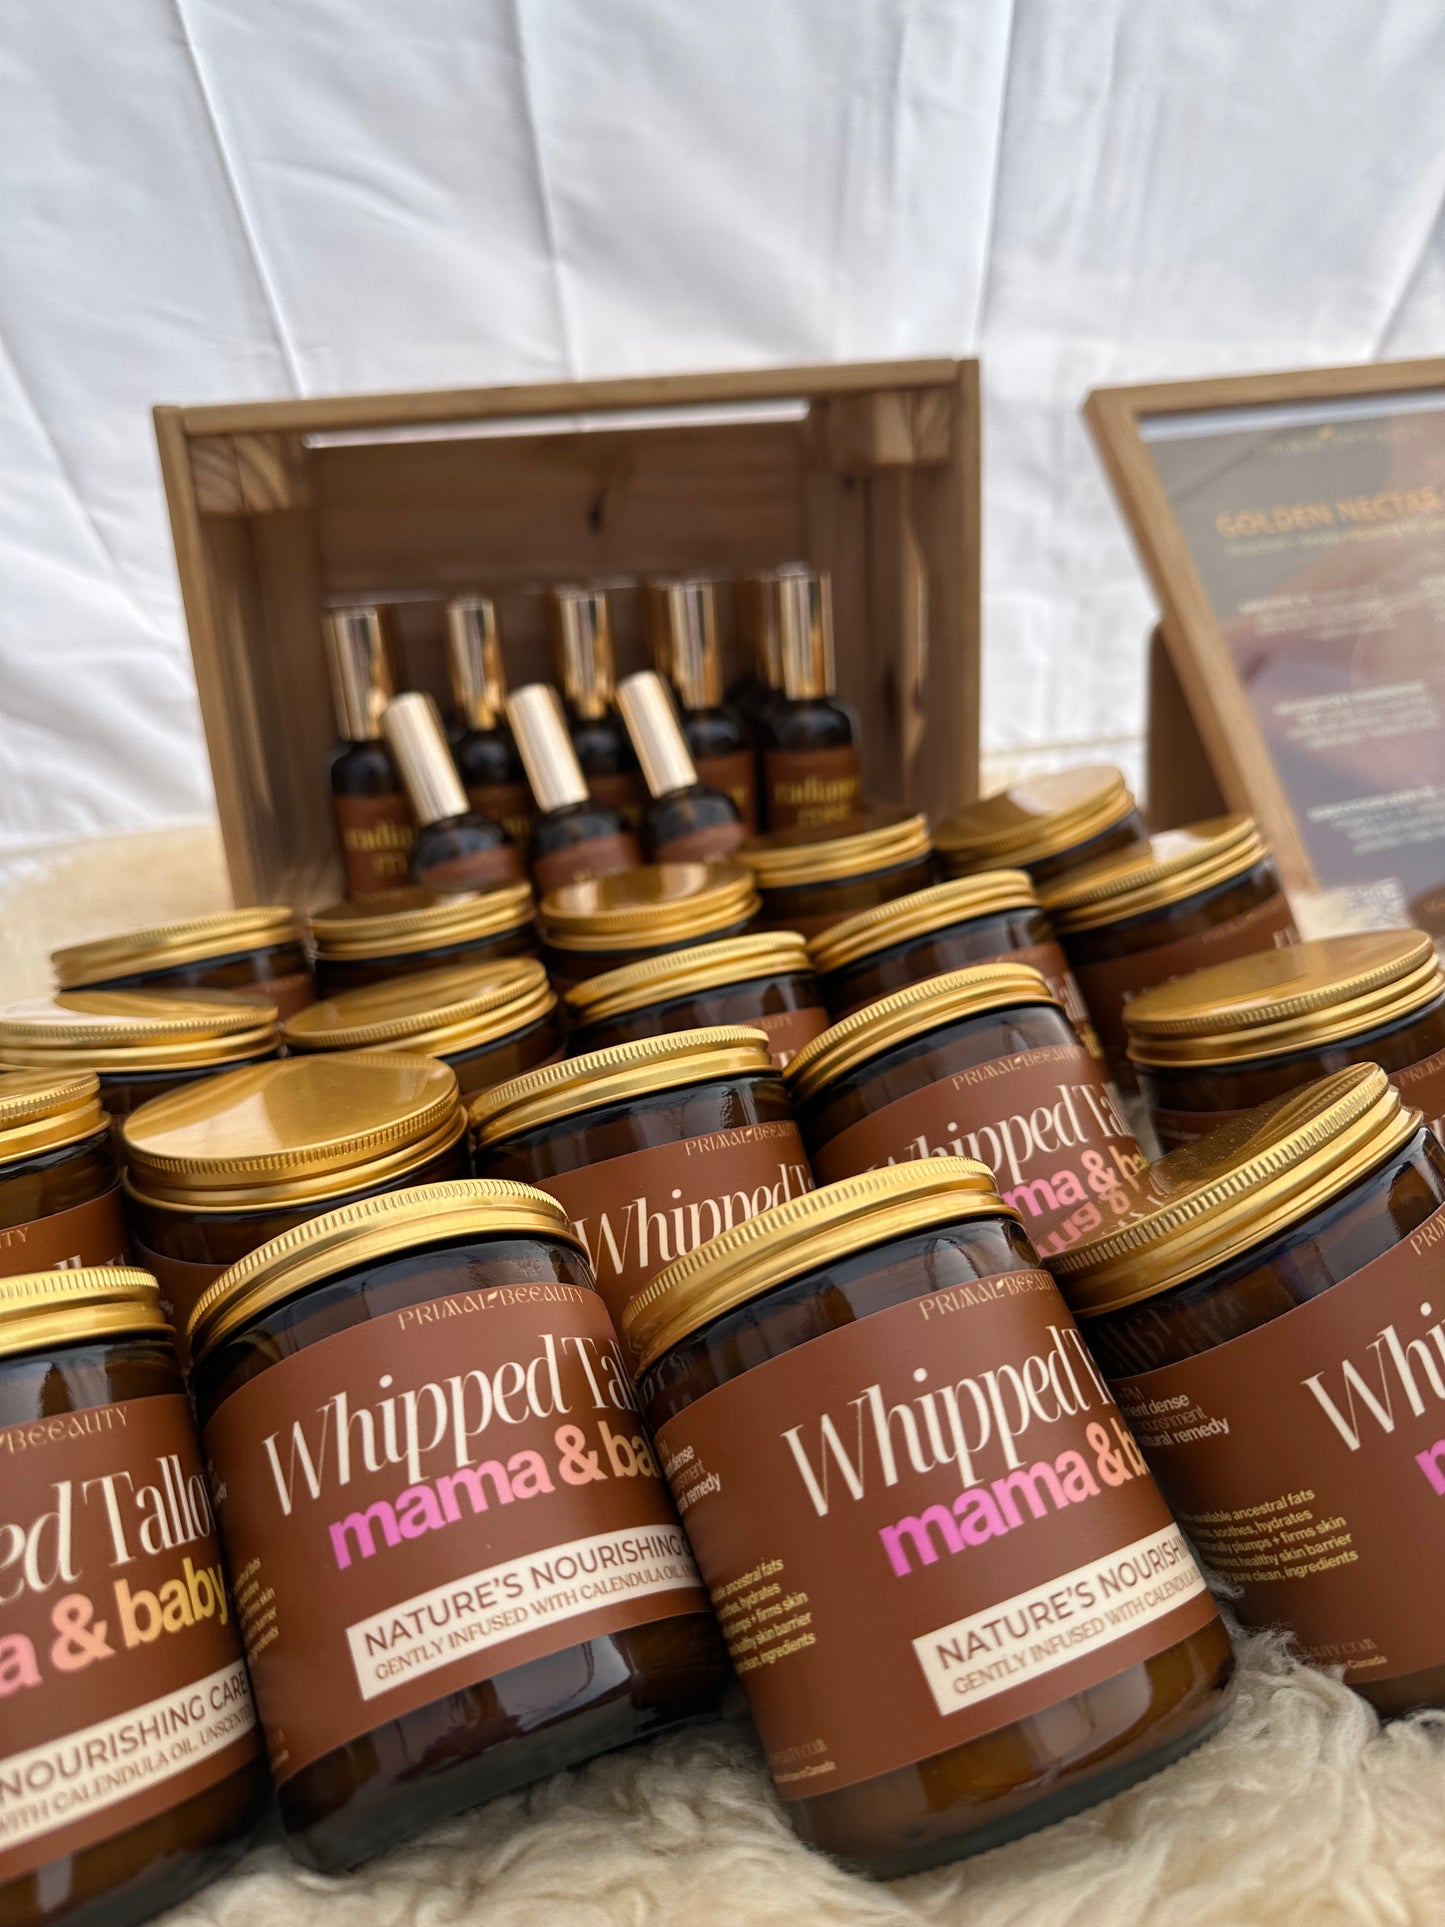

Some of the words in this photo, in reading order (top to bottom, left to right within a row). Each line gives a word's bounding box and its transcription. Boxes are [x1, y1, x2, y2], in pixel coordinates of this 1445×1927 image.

[952, 1059, 1022, 1091] PRIMAL
[685, 1132, 752, 1156] PRIMAL
[1002, 1169, 1088, 1217] ma
[1080, 1149, 1122, 1193] &
[1410, 1213, 1445, 1256] PRIM
[398, 1293, 495, 1331] PRIMAL
[499, 1285, 585, 1307] BEEAUTY
[918, 1281, 1005, 1321] PRIMAL
[262, 1333, 573, 1516] Whipped
[780, 1325, 1090, 1517] Whipped
[1149, 1394, 1190, 1415] dense
[7, 1405, 128, 1453] BEEAUTY
[1173, 1416, 1231, 1445] remedy
[329, 1450, 557, 1571] mama
[554, 1424, 608, 1486] &
[686, 1472, 721, 1505] remedy
[878, 1450, 1101, 1578] mama
[1086, 1421, 1134, 1488] &
[1232, 1496, 1289, 1522] ancestral
[1287, 1487, 1316, 1508] fats
[81, 1454, 217, 1568] Tallo
[1256, 1508, 1314, 1534] hydrates
[1279, 1525, 1317, 1545] firms
[1314, 1514, 1348, 1535] skin
[1278, 1545, 1308, 1563] skin
[1306, 1532, 1352, 1558] barrier
[1284, 1548, 1360, 1579] ingredients
[51, 1593, 116, 1662] &
[113, 1556, 229, 1649] baby
[364, 1571, 524, 1657] NATURE'S
[530, 1534, 683, 1591] NOURISHING
[782, 1591, 809, 1612] skin
[375, 1637, 447, 1681] GENTLY
[450, 1605, 530, 1649] INFUSED
[529, 1590, 580, 1618] WITH
[579, 1566, 666, 1601] CALENDULA
[773, 1611, 812, 1638] barrier
[935, 1579, 1096, 1670] NATURE'S
[952, 1651, 1026, 1695] GENTLY
[1031, 1615, 1106, 1664] INFUSED
[1104, 1596, 1144, 1626] WITH
[760, 1632, 818, 1665] ingredients
[0, 1694, 206, 1802] NOURISHING
[208, 1669, 248, 1711] CARE
[53, 1754, 170, 1813] CALENDULA
